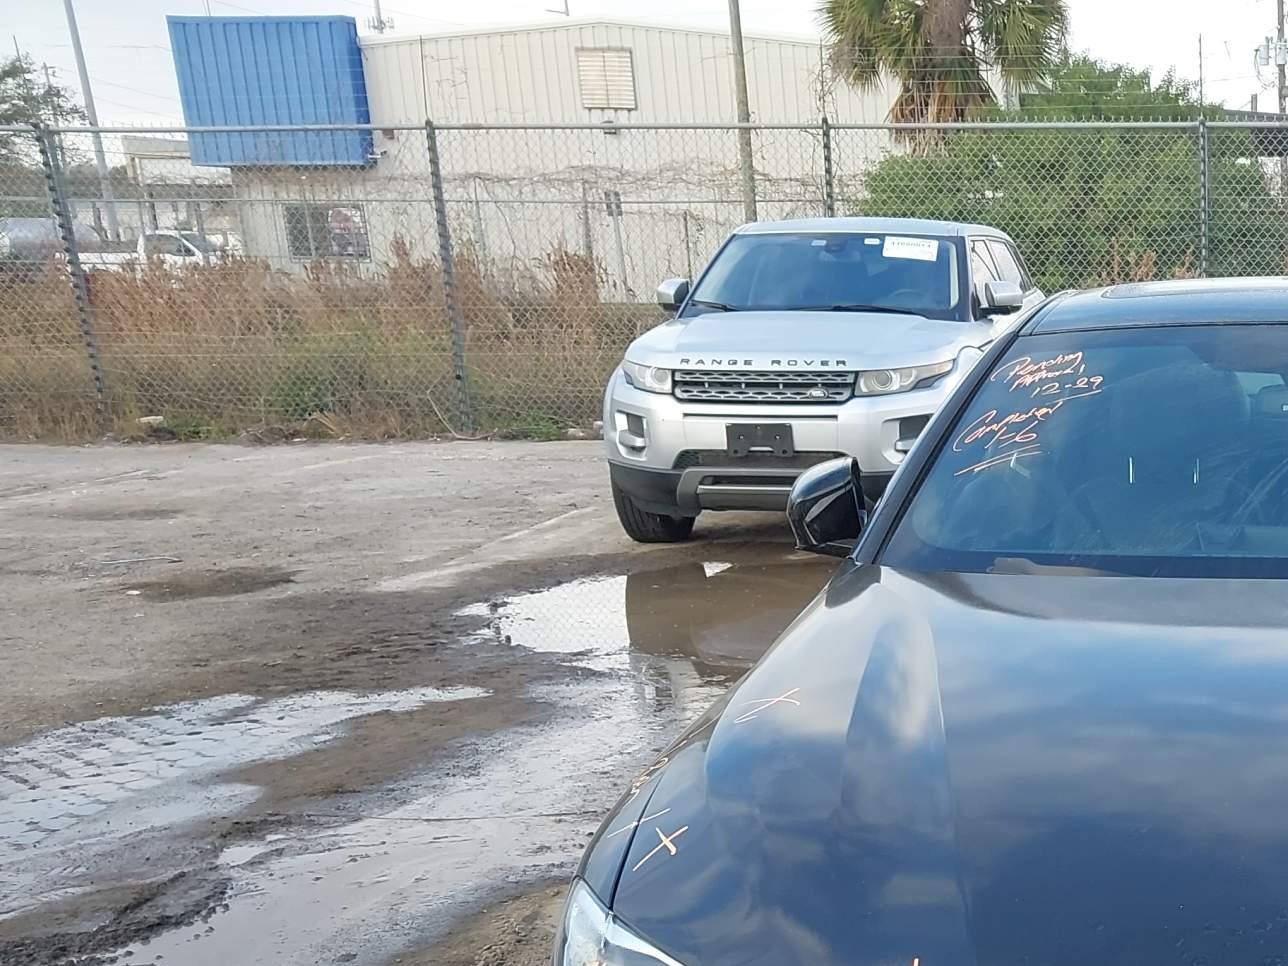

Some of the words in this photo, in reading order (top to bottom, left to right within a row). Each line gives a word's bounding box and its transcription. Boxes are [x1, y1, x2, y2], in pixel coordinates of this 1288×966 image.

[680, 358, 753, 366] RANGE
[770, 359, 847, 367] ROVER
[1030, 375, 1104, 399] 12-29
